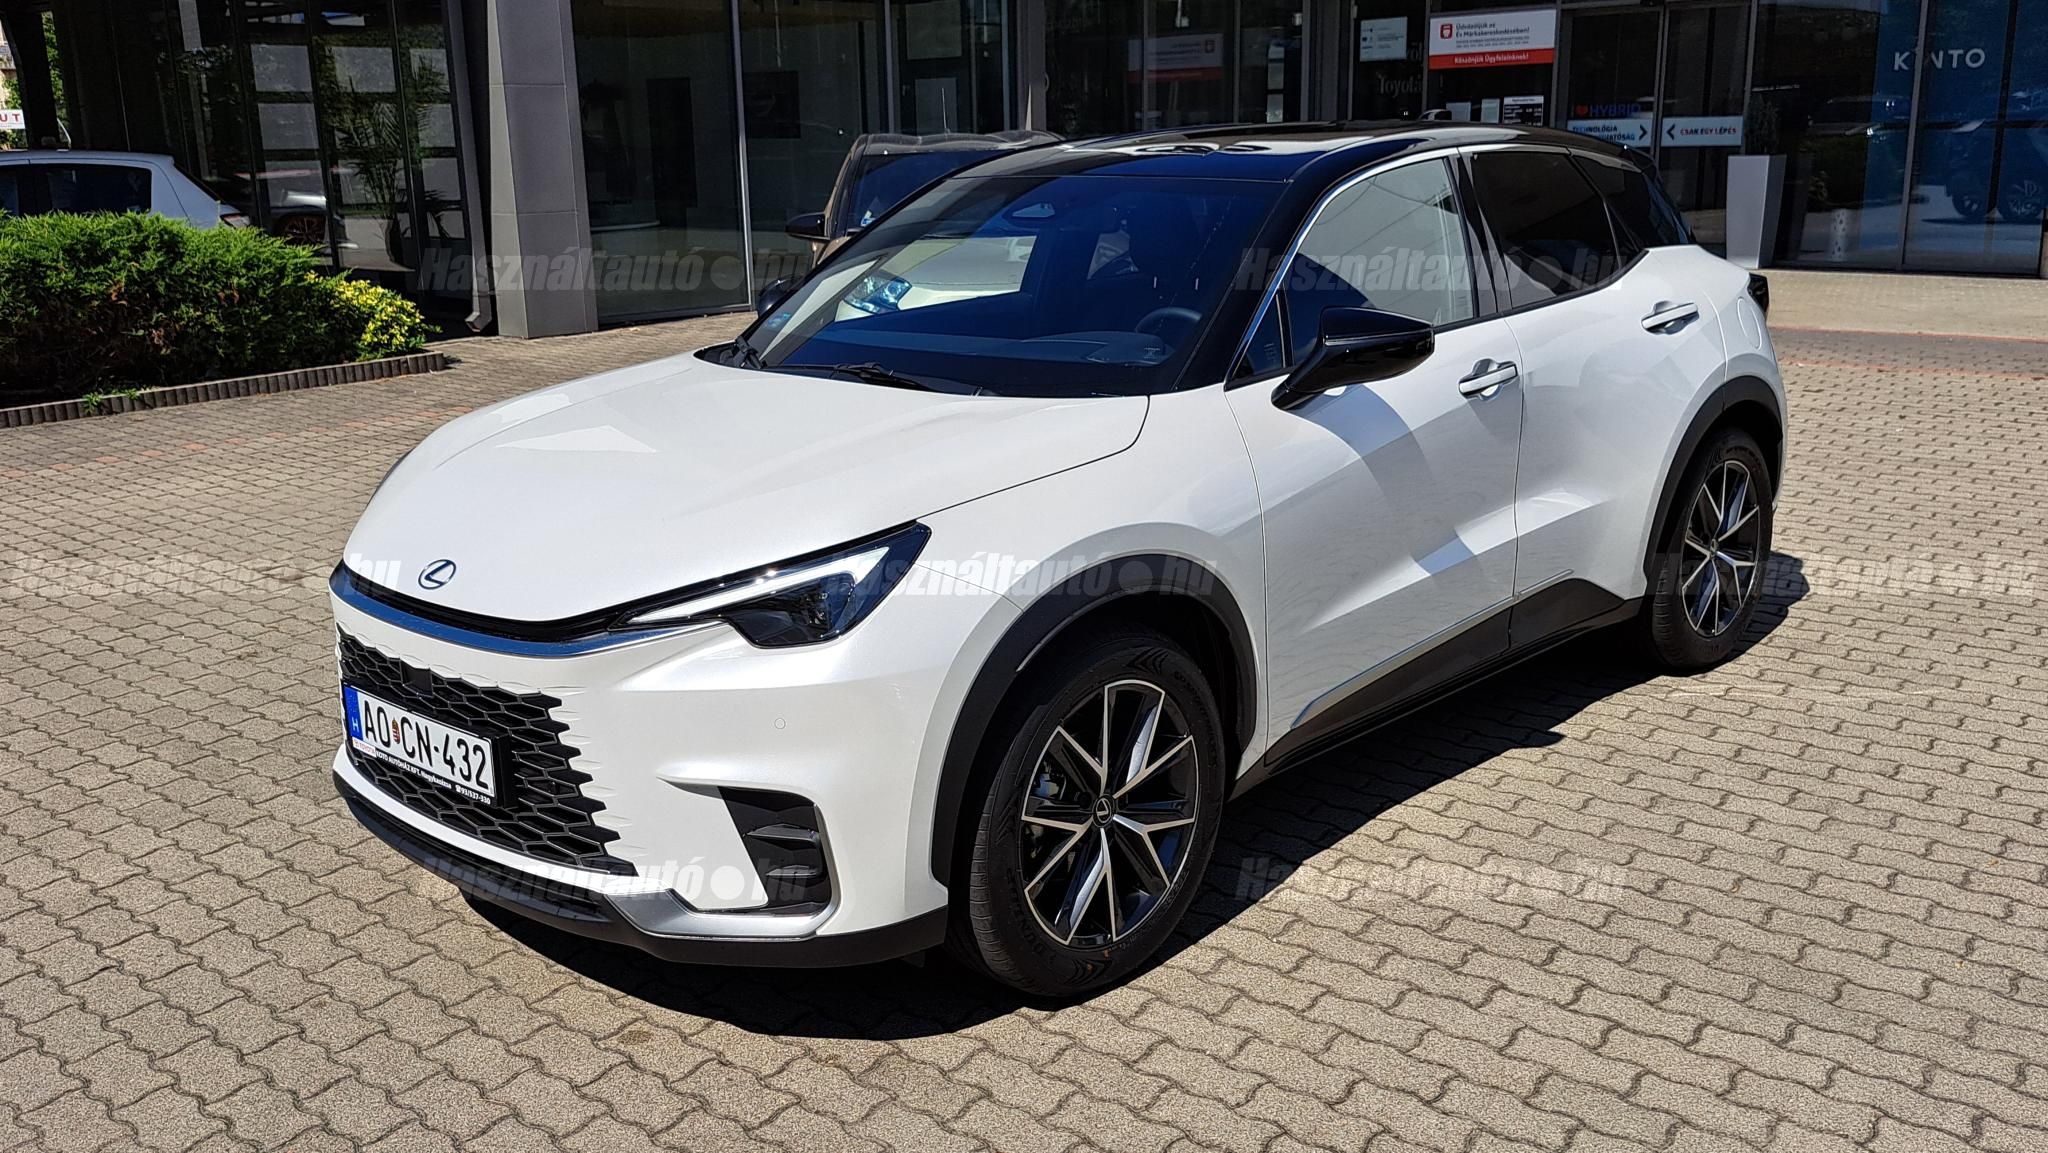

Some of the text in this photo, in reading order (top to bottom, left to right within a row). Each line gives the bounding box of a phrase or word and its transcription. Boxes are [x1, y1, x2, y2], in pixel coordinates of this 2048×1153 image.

[1894, 48, 1986, 71] KNTO
[1680, 125, 1737, 136] CSAK EGY LÉPÉS
[352, 717, 360, 733] H
[400, 716, 489, 790] CN-432
